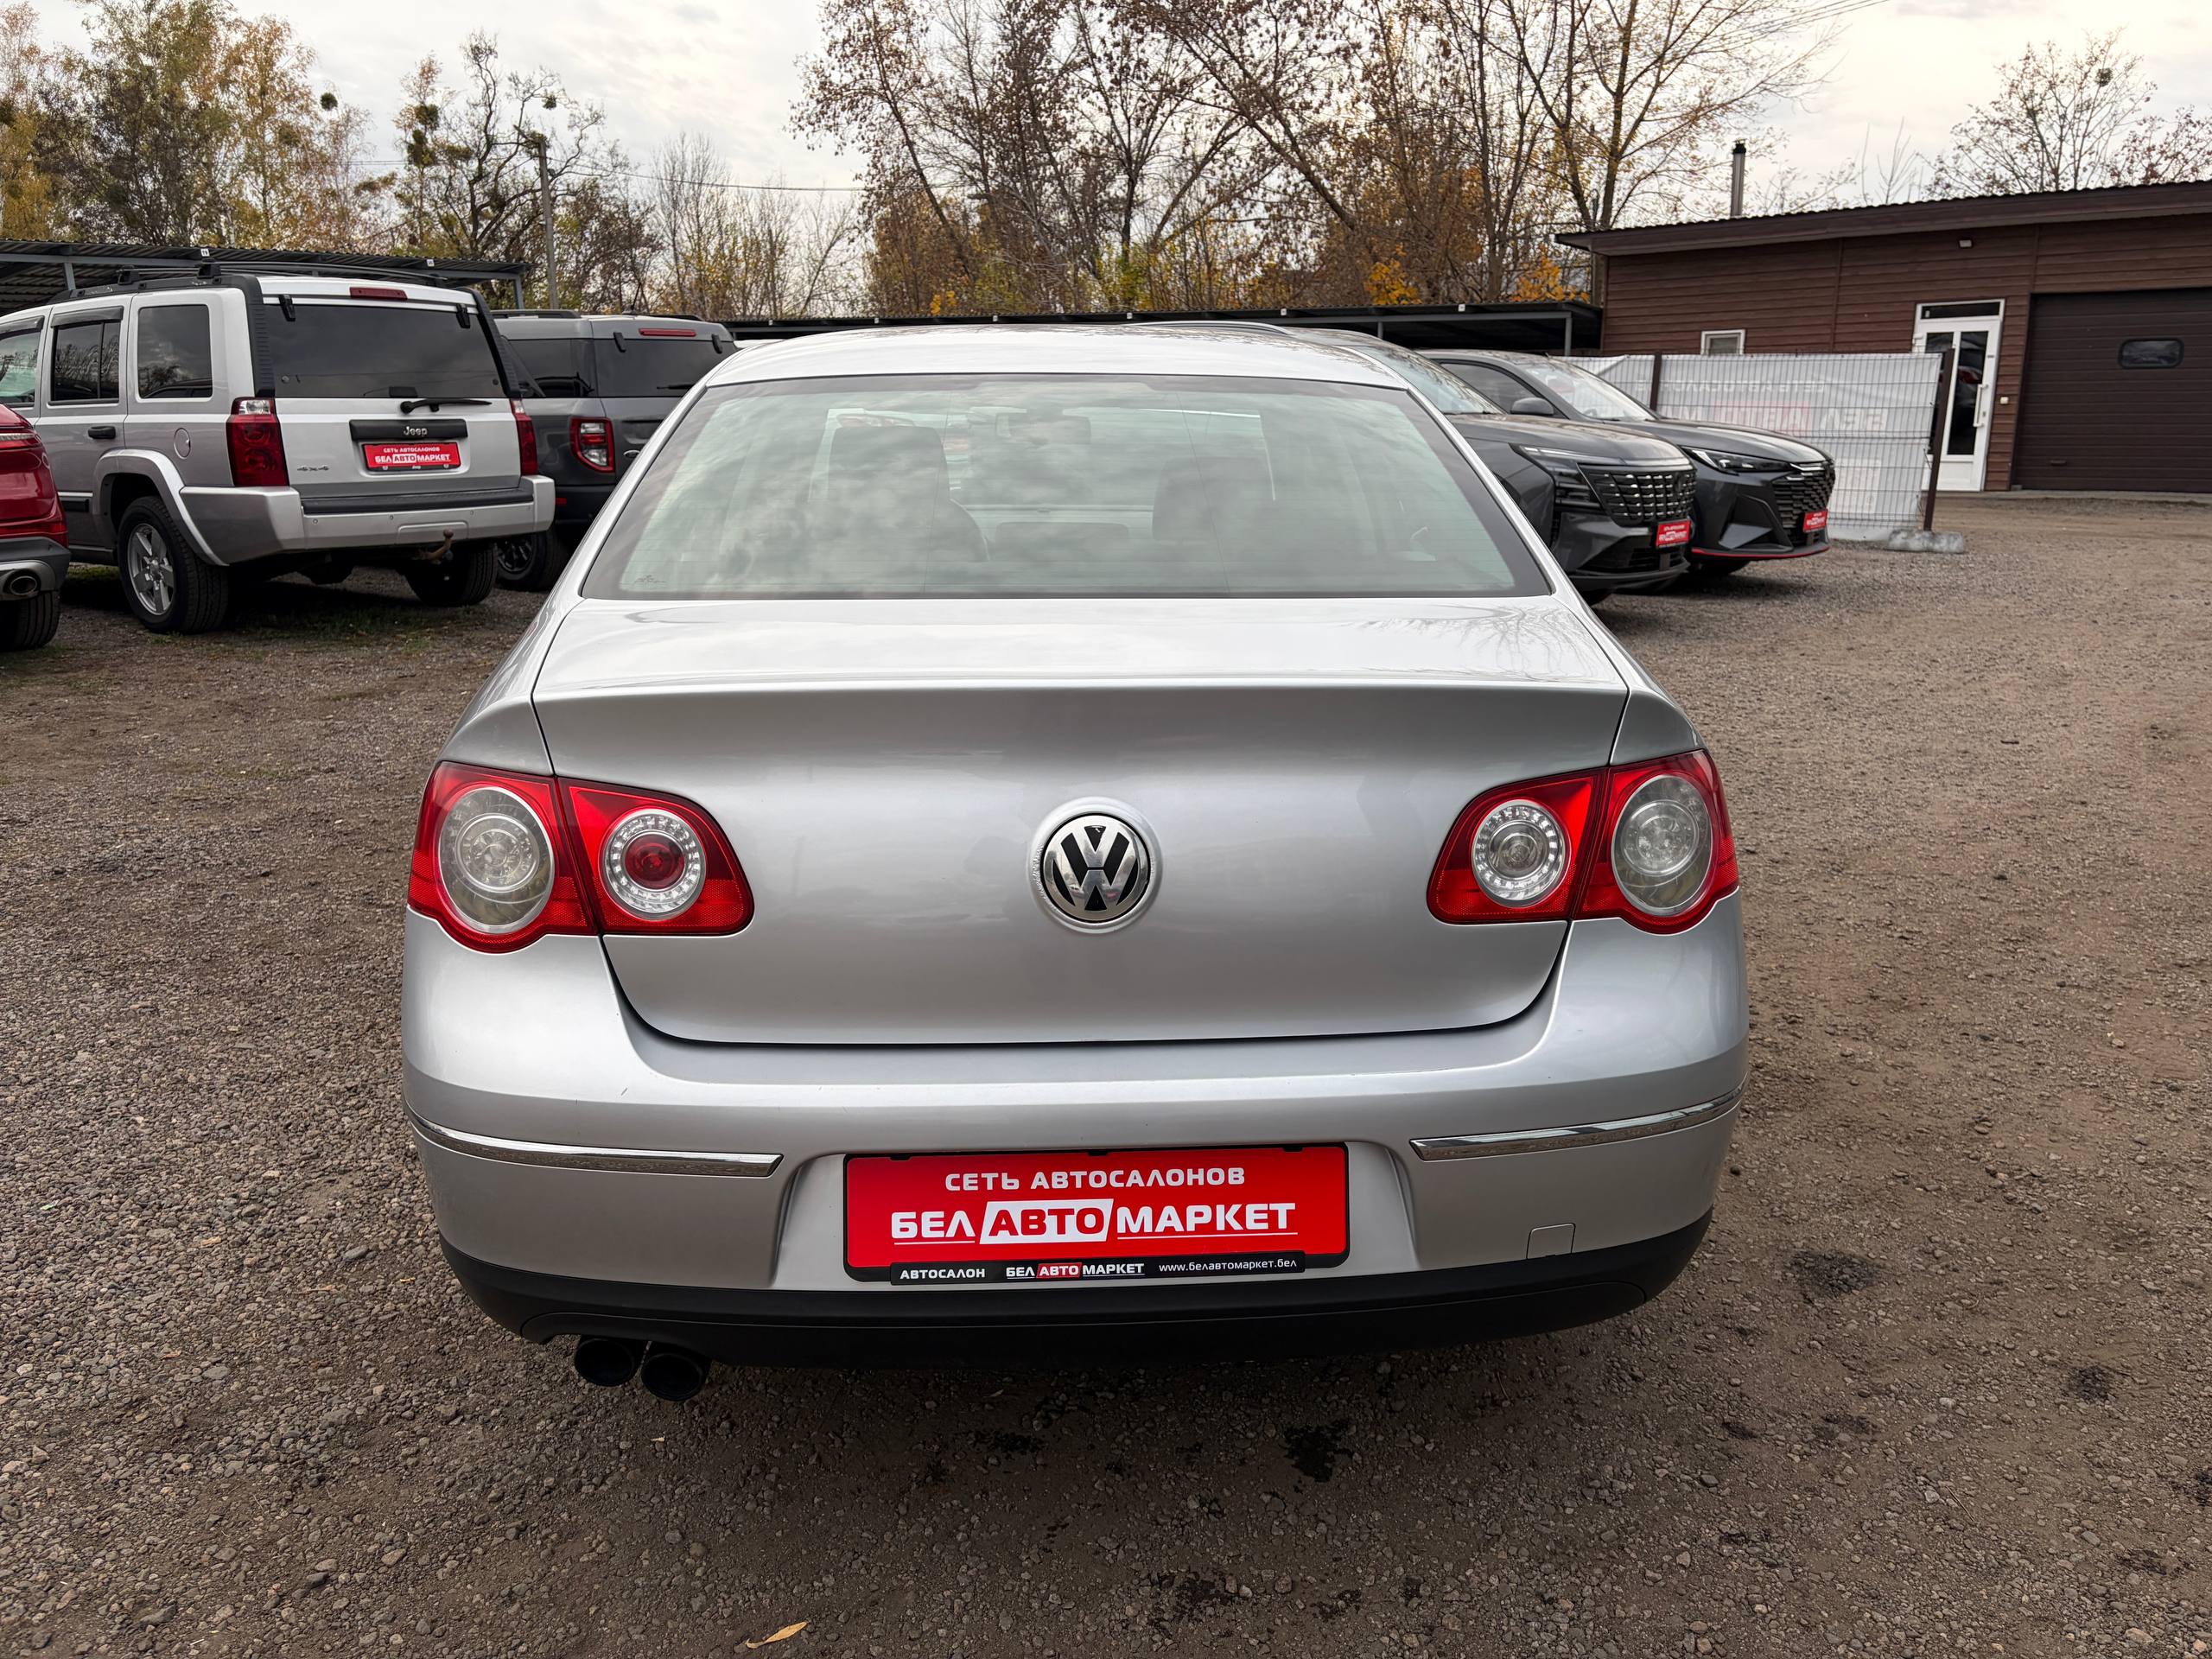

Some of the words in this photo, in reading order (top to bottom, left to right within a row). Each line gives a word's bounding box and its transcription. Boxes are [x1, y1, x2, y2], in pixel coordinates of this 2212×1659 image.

[404, 426, 428, 437] Jeep
[945, 1172, 1020, 1192] СЕТЬ
[1030, 1167, 1245, 1190] АВТОСАЛОНОВ
[899, 1268, 985, 1280] АВТОСАЛОН
[1158, 1258, 1298, 1273] www.белавтомаркет.бел
